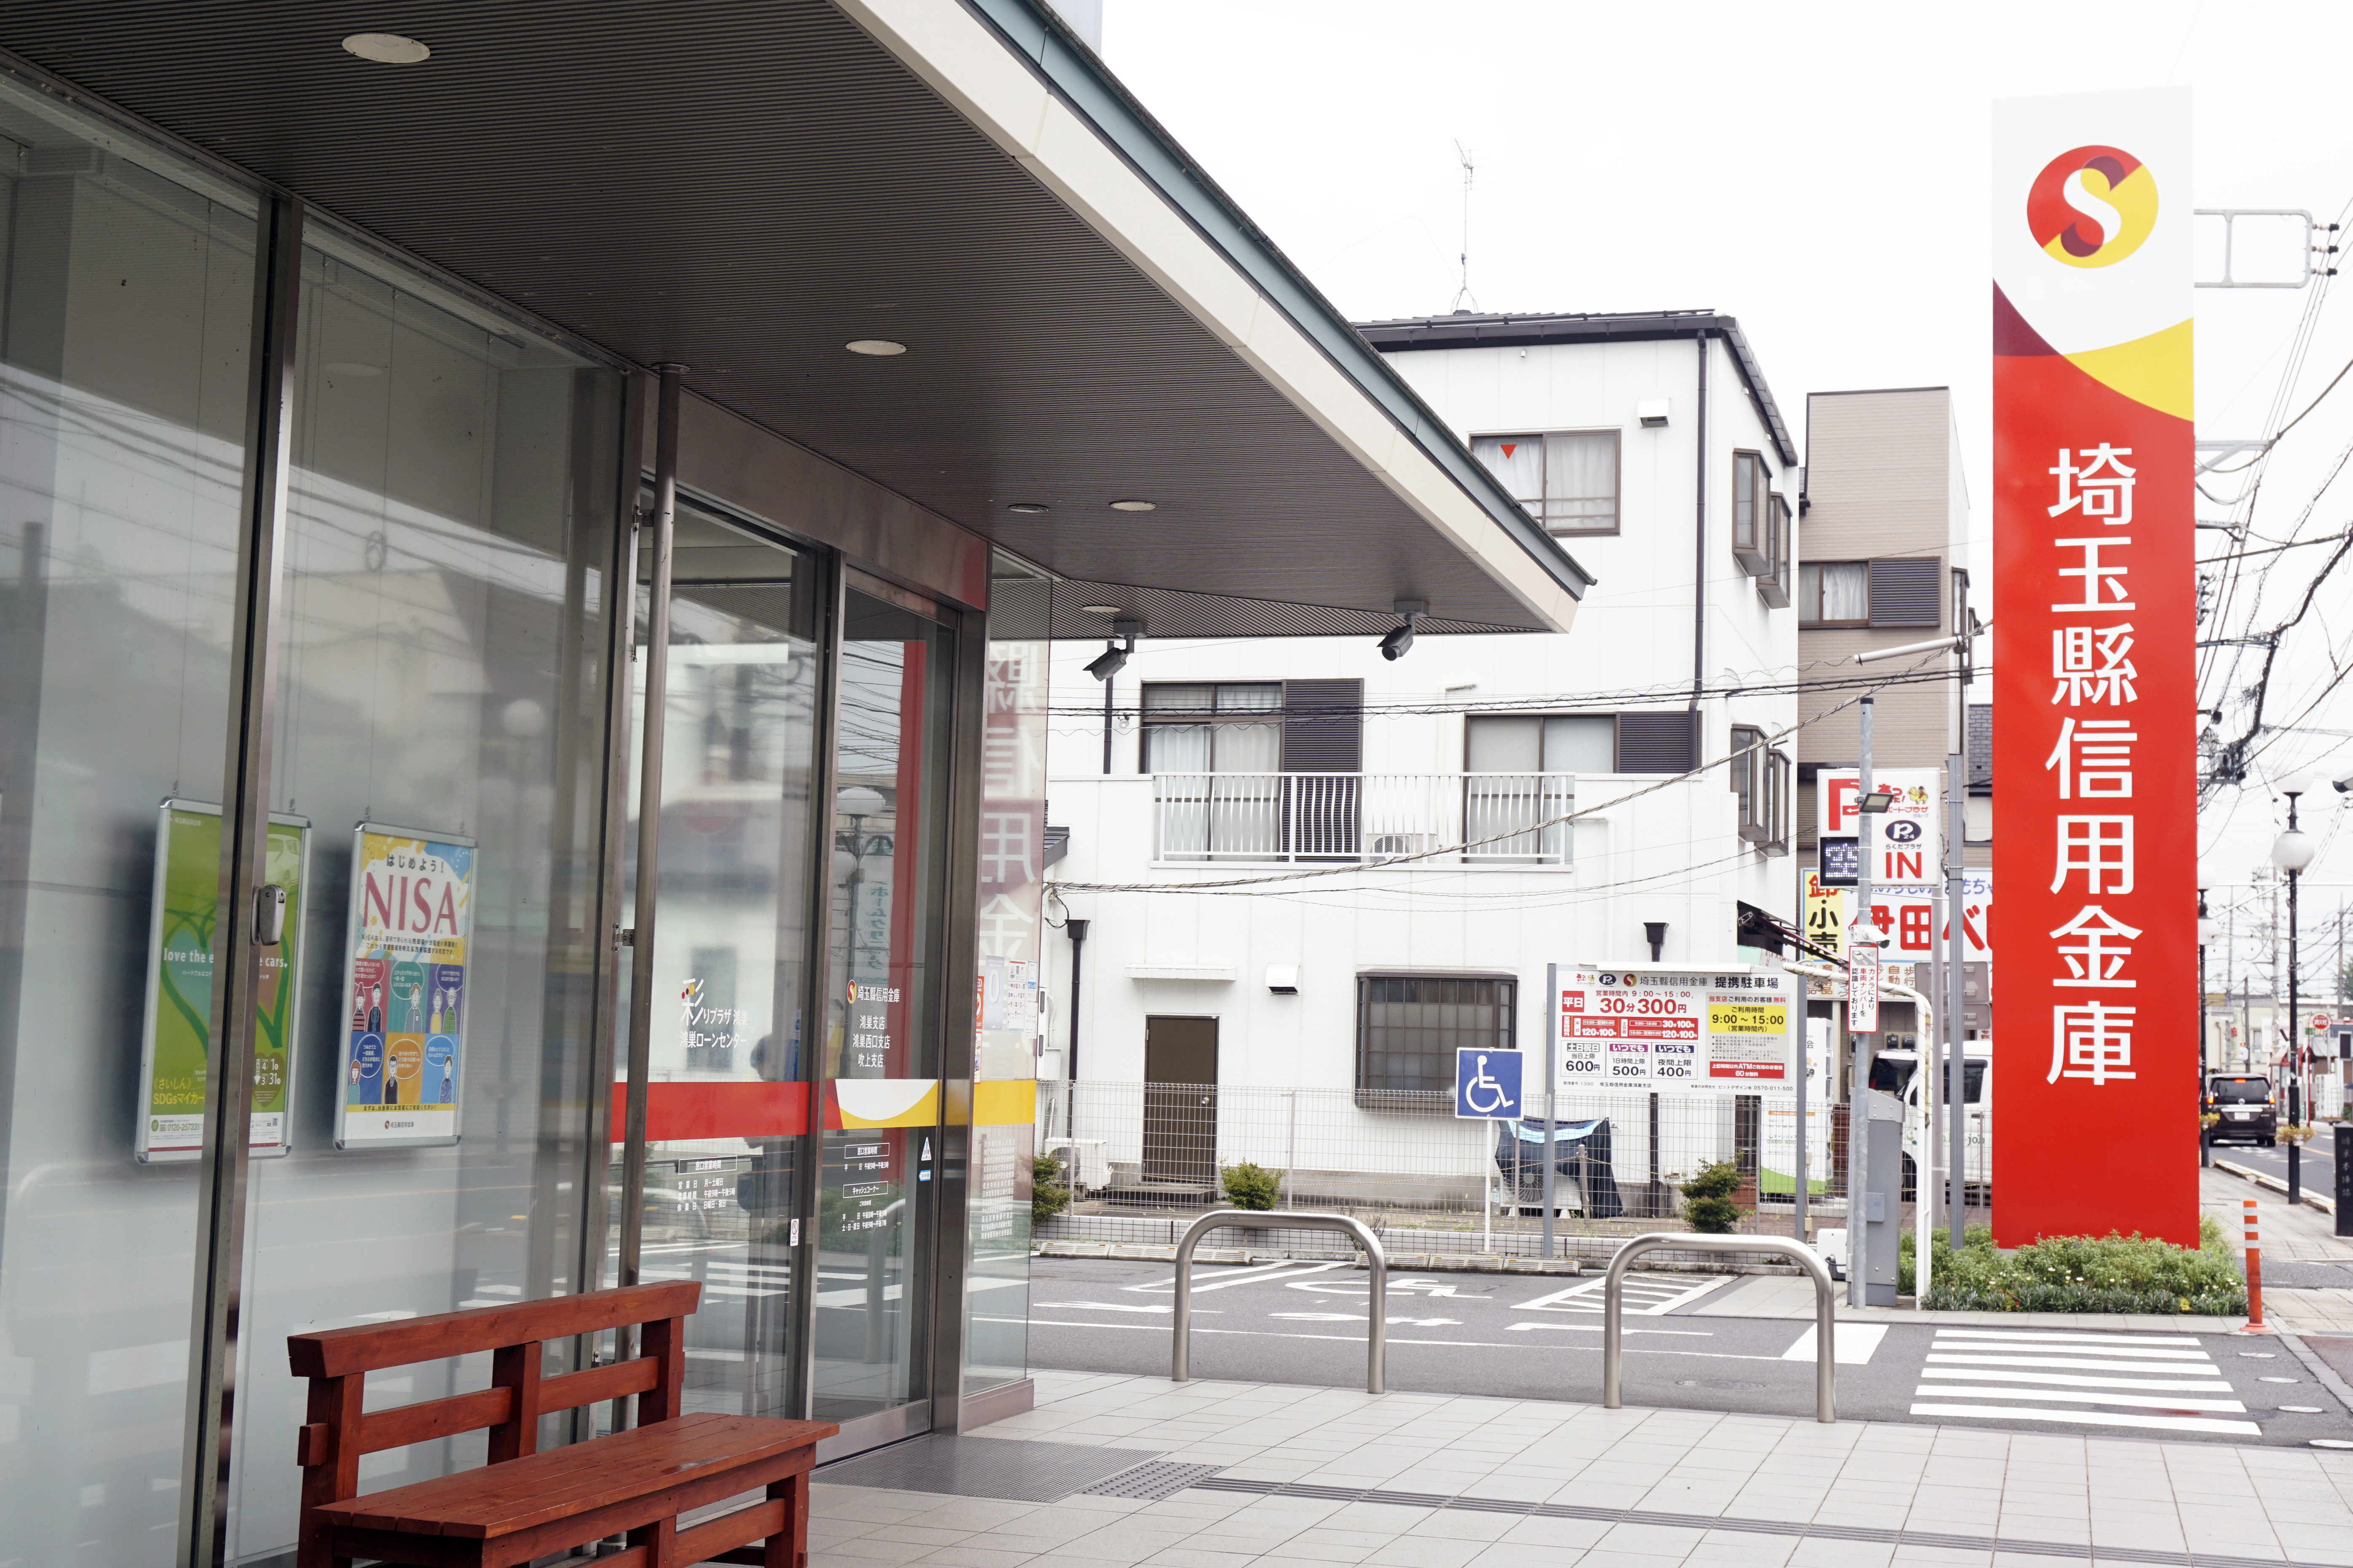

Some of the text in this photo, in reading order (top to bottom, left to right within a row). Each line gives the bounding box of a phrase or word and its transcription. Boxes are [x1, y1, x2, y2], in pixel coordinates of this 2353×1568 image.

[2045, 443, 2143, 1086] 埼玉縣信用金庫
[387, 854, 444, 873] はじめよう!
[1886, 852, 1922, 879] IN
[362, 872, 458, 935] NISA
[164, 947, 185, 962] love
[189, 950, 205, 963] the
[1639, 976, 1779, 989] 埼玉縣信用金庫 提携駐車場
[857, 985, 900, 1003] 埼玉縣信用金庫
[1563, 997, 1583, 1008] 平日
[732, 1010, 748, 1026] 鴻巣
[859, 1015, 885, 1030] 鴻巣支店
[1575, 1021, 1580, 1032] 平日
[680, 1031, 747, 1049] 鴻巣ローンセンター
[852, 1033, 891, 1049] 鴻巣西口支店
[1568, 1043, 1599, 1052] 土日祝日
[1658, 1045, 1691, 1053] いつでも
[858, 1053, 884, 1068] 吹上支店
[1566, 1060, 1600, 1072] 600円
[1612, 1066, 1646, 1076] 500円
[1657, 1067, 1691, 1077] 400円
[167, 1123, 200, 1131] 0120-257231
[857, 1146, 877, 1155] 窓口営業時間
[695, 1160, 722, 1171] 窓口営業時間
[678, 1180, 698, 1190] 営業日
[852, 1185, 880, 1195] キャッシュコーナー
[678, 1191, 697, 1201] 営業時間
[677, 1202, 697, 1212] 休業日
